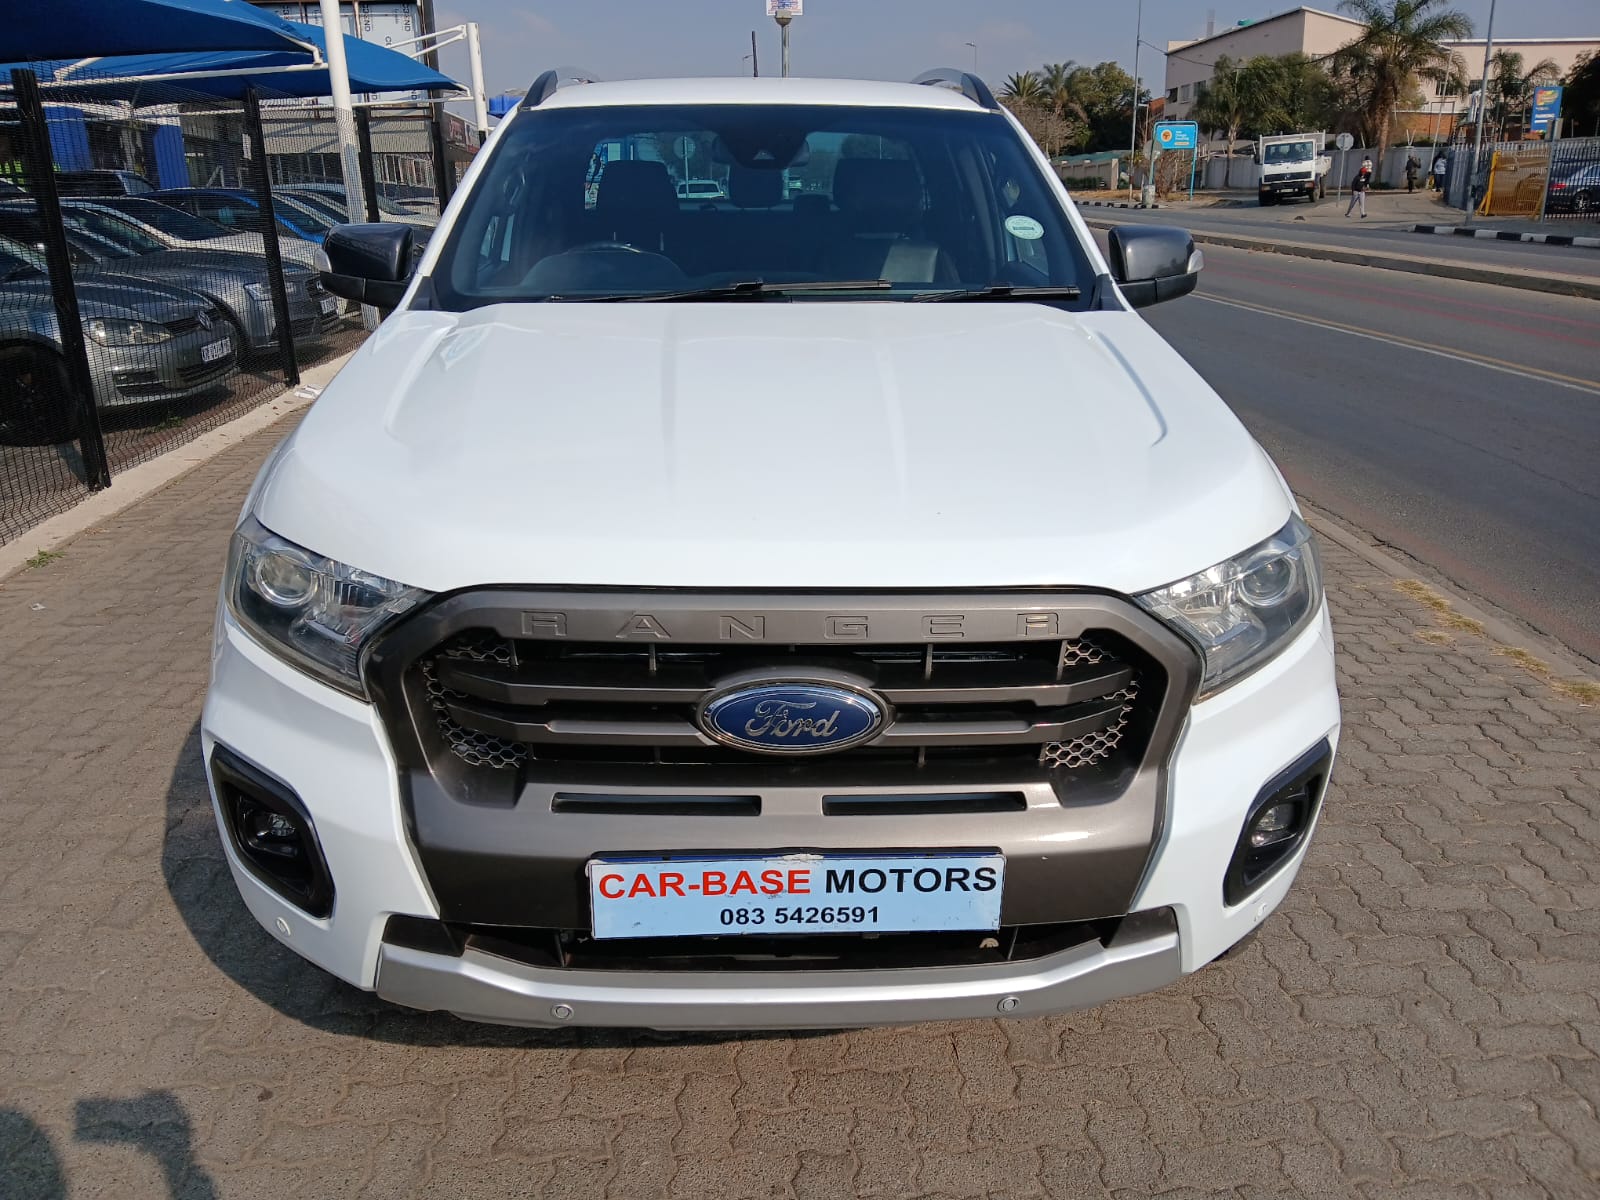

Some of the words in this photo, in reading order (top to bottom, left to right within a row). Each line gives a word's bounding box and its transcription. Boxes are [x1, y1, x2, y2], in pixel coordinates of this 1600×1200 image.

[520, 609, 1060, 641] RANGER
[744, 700, 840, 739] Ford
[599, 869, 811, 898] CAR-BASE
[825, 867, 997, 894] MOTORS
[719, 907, 765, 925] 083
[774, 906, 879, 924] 5426591
